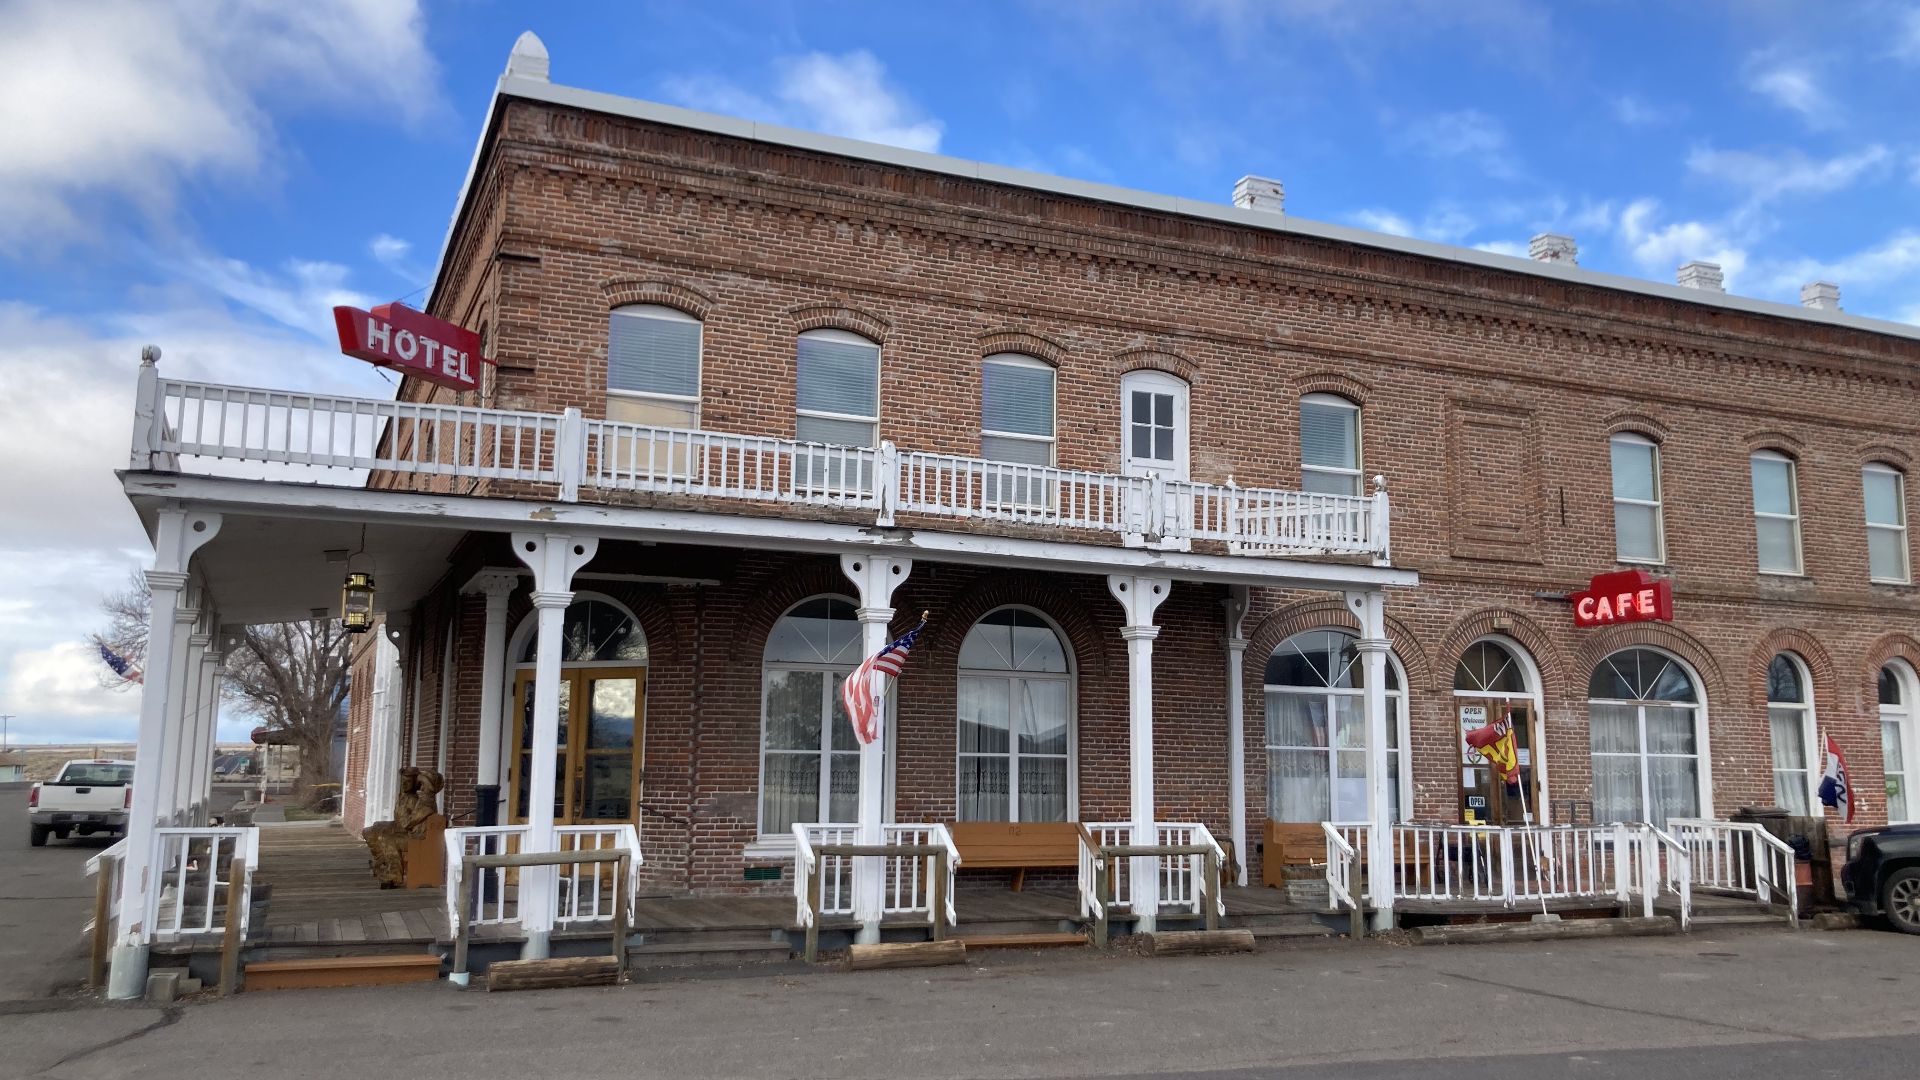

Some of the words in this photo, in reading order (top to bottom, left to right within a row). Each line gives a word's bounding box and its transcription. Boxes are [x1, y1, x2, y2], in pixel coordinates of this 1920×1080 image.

[367, 317, 475, 385] HOTEL
[1577, 589, 1655, 620] CAFE
[1464, 707, 1482, 715] OPEN
[1470, 797, 1484, 806] OPEN
